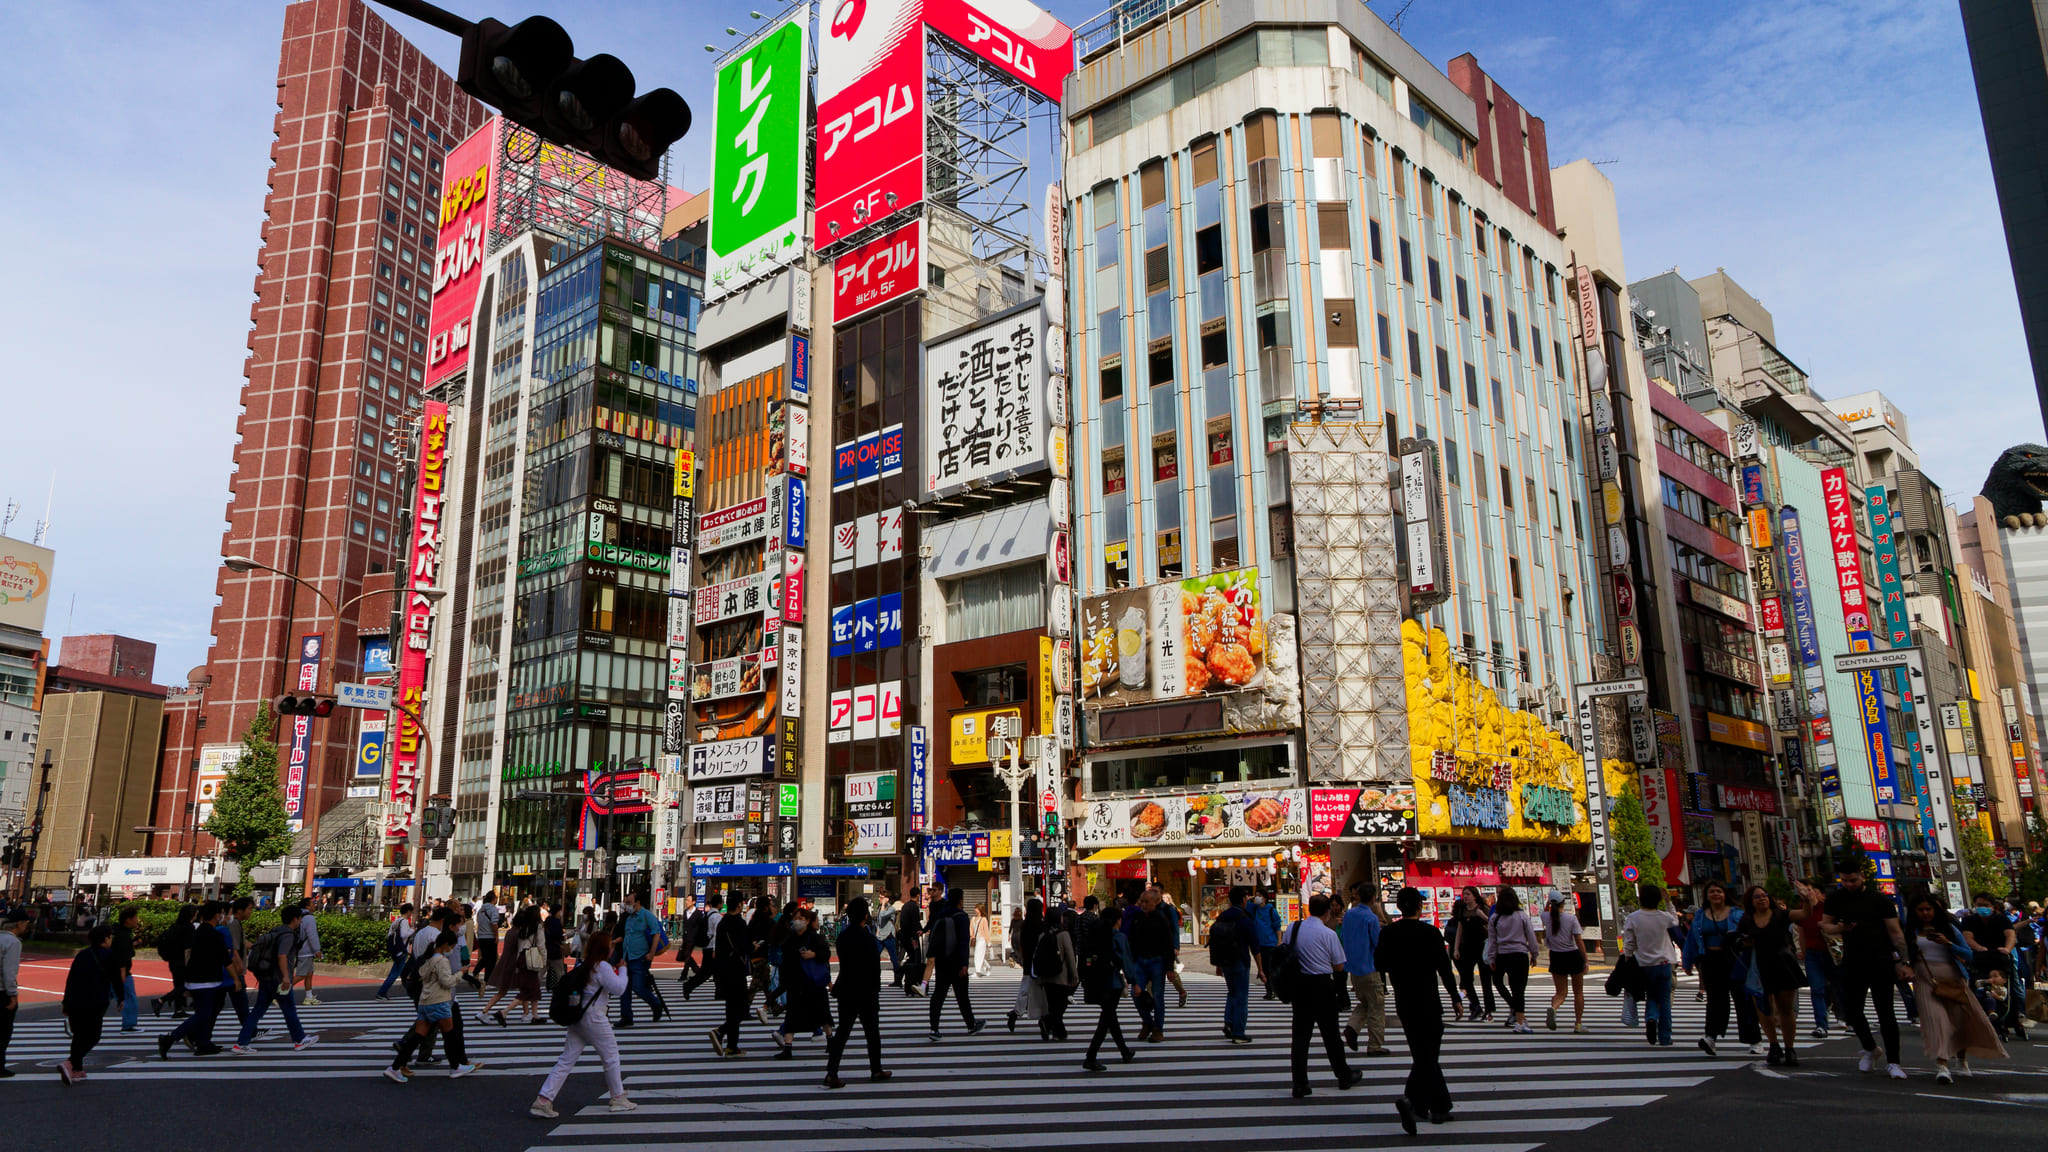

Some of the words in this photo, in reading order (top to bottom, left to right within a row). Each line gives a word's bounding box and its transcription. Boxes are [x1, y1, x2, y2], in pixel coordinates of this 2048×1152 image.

[967, 13, 1036, 78] アコム
[732, 58, 772, 217] レイク
[824, 84, 914, 161] アコム
[439, 164, 487, 228] パチンコ
[434, 217, 483, 294] エスパス
[837, 240, 916, 296] アイフル
[797, 274, 807, 321] 戸谷ビル
[880, 280, 895, 295] 5F
[649, 305, 685, 329] BAR
[795, 341, 804, 380] PROMISE
[631, 361, 697, 392] POKER
[1010, 323, 1034, 456] おやじが喜ぶ
[959, 338, 995, 468] 酒と肴
[994, 346, 1014, 459] こだわりの
[937, 371, 961, 481] だけの店
[424, 414, 445, 491] パチンコ
[839, 434, 901, 470] PROMISE
[591, 515, 601, 539] ダーツ
[791, 486, 800, 538] セントラル
[768, 536, 783, 552] 本
[1826, 475, 1863, 606] カラオケ歌広場
[724, 586, 759, 615] 本陣
[789, 579, 798, 610] アコム
[1204, 586, 1218, 634] チキンが
[833, 610, 901, 642] セントラル
[1190, 612, 1206, 653] たべたい。
[1222, 609, 1238, 652] 猛烈に
[766, 650, 778, 660] AT
[864, 640, 873, 649] 4F
[1086, 609, 1102, 698] レモンサワー
[1162, 640, 1173, 657] 光
[1839, 656, 1880, 667] CENTRAL
[1882, 653, 1907, 662] ROAD
[715, 670, 736, 682] 粉もの
[715, 682, 736, 694] 専門店
[1162, 681, 1175, 694] 4F
[344, 686, 387, 700] 歌舞伎町
[351, 697, 379, 706] Kabukicho
[516, 687, 566, 708] BEAUTY
[400, 687, 421, 752] パチンコ
[832, 691, 900, 727] アコム
[708, 741, 757, 758] メンズライフ
[836, 732, 846, 742] 3F
[222, 752, 240, 761] Bric
[361, 743, 384, 764] G
[708, 759, 747, 775] クリニック
[785, 751, 794, 772] 販売
[1915, 694, 1948, 831] ゴジラロード
[286, 767, 302, 815] 開催中
[697, 791, 712, 801] 大衆
[850, 782, 875, 796] BUY
[1581, 713, 1596, 798] GODZILLA
[1591, 809, 1605, 851] ROAD
[697, 802, 712, 813] 酒場
[1293, 790, 1303, 821] かつ丼
[1643, 775, 1659, 826] トラノコ
[860, 823, 892, 837] SELL
[1166, 831, 1180, 840] 580
[1223, 828, 1240, 838] 600
[1284, 824, 1301, 835] 590
